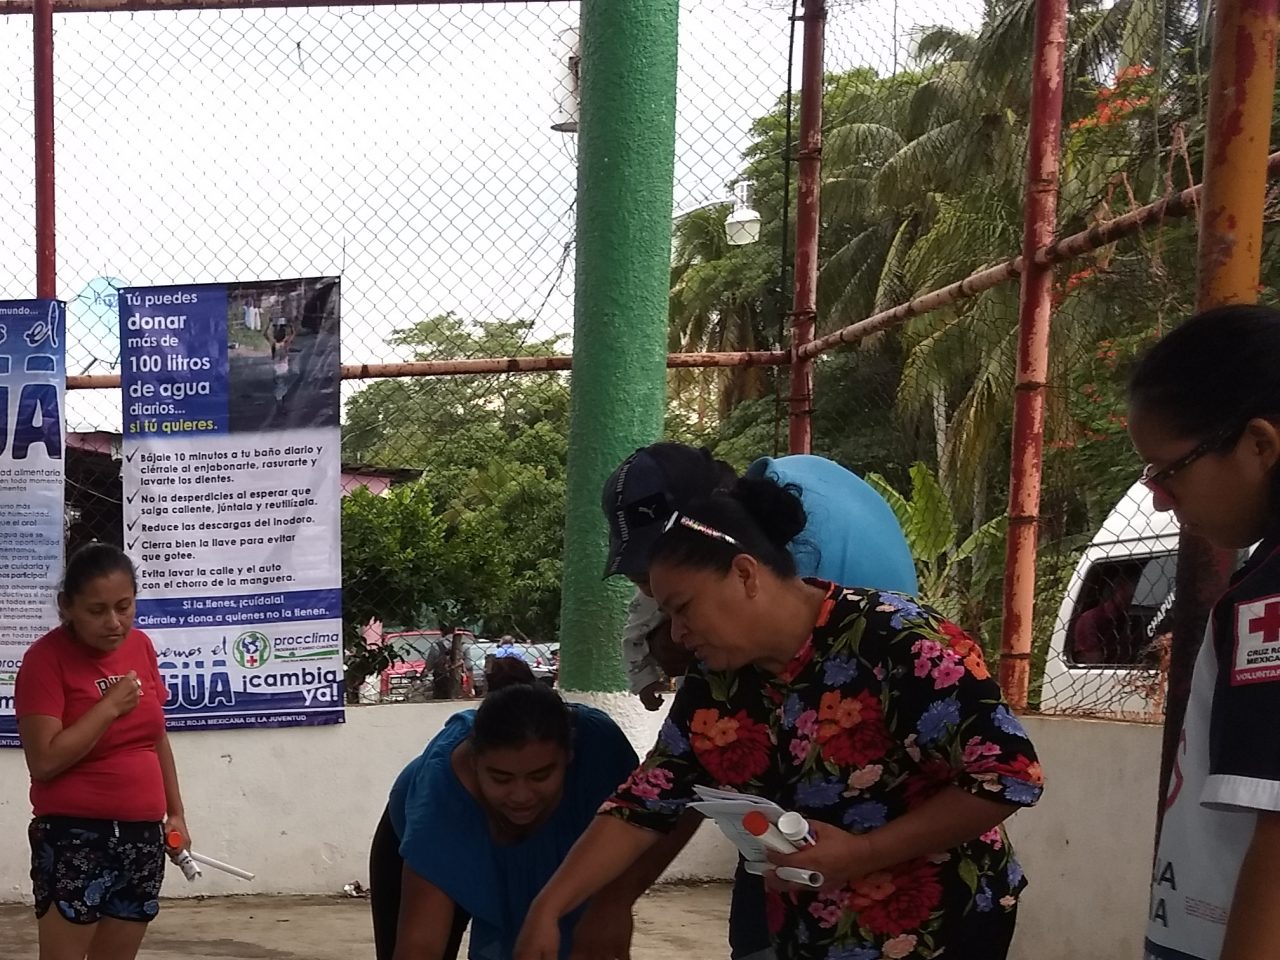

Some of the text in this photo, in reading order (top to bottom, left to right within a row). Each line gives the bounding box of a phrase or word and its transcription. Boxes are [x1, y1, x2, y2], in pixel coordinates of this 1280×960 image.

[126, 293, 198, 307] Tú puedes
[0, 307, 38, 315] mundo...
[24, 301, 58, 347] el
[128, 314, 186, 330] donar
[128, 335, 178, 347] más de
[129, 355, 210, 372] 100 litros
[129, 381, 210, 399] de agua
[130, 403, 185, 415] diarios...
[130, 420, 217, 433] si tú quieres.
[141, 453, 171, 463] Bájale
[174, 453, 185, 461] 10
[189, 452, 228, 461] minutos
[241, 450, 250, 459] tu
[254, 448, 281, 458] baño
[284, 446, 314, 456] diario
[317, 447, 322, 456] y
[141, 459, 317, 474] ciérrale al enjabonarte, rasurarte y
[141, 475, 234, 486] lavarte los dientes.
[141, 487, 311, 504] No la desperdicies al esperar que
[141, 497, 318, 516] salga caliente, júntala y reutilízala.
[142, 515, 315, 533] Reduce las descargas del inodoro.
[138, 615, 176, 625] Ciérrale
[179, 617, 185, 625] y
[187, 614, 213, 623] dona
[226, 612, 264, 623] quienes
[267, 611, 279, 619] no
[282, 610, 291, 618] la
[295, 608, 329, 617] tienen.
[211, 636, 227, 656] el
[274, 633, 339, 648] procclima
[242, 667, 337, 691] ¡cambia
[158, 672, 235, 709] GUA
[303, 683, 338, 706] ya!
